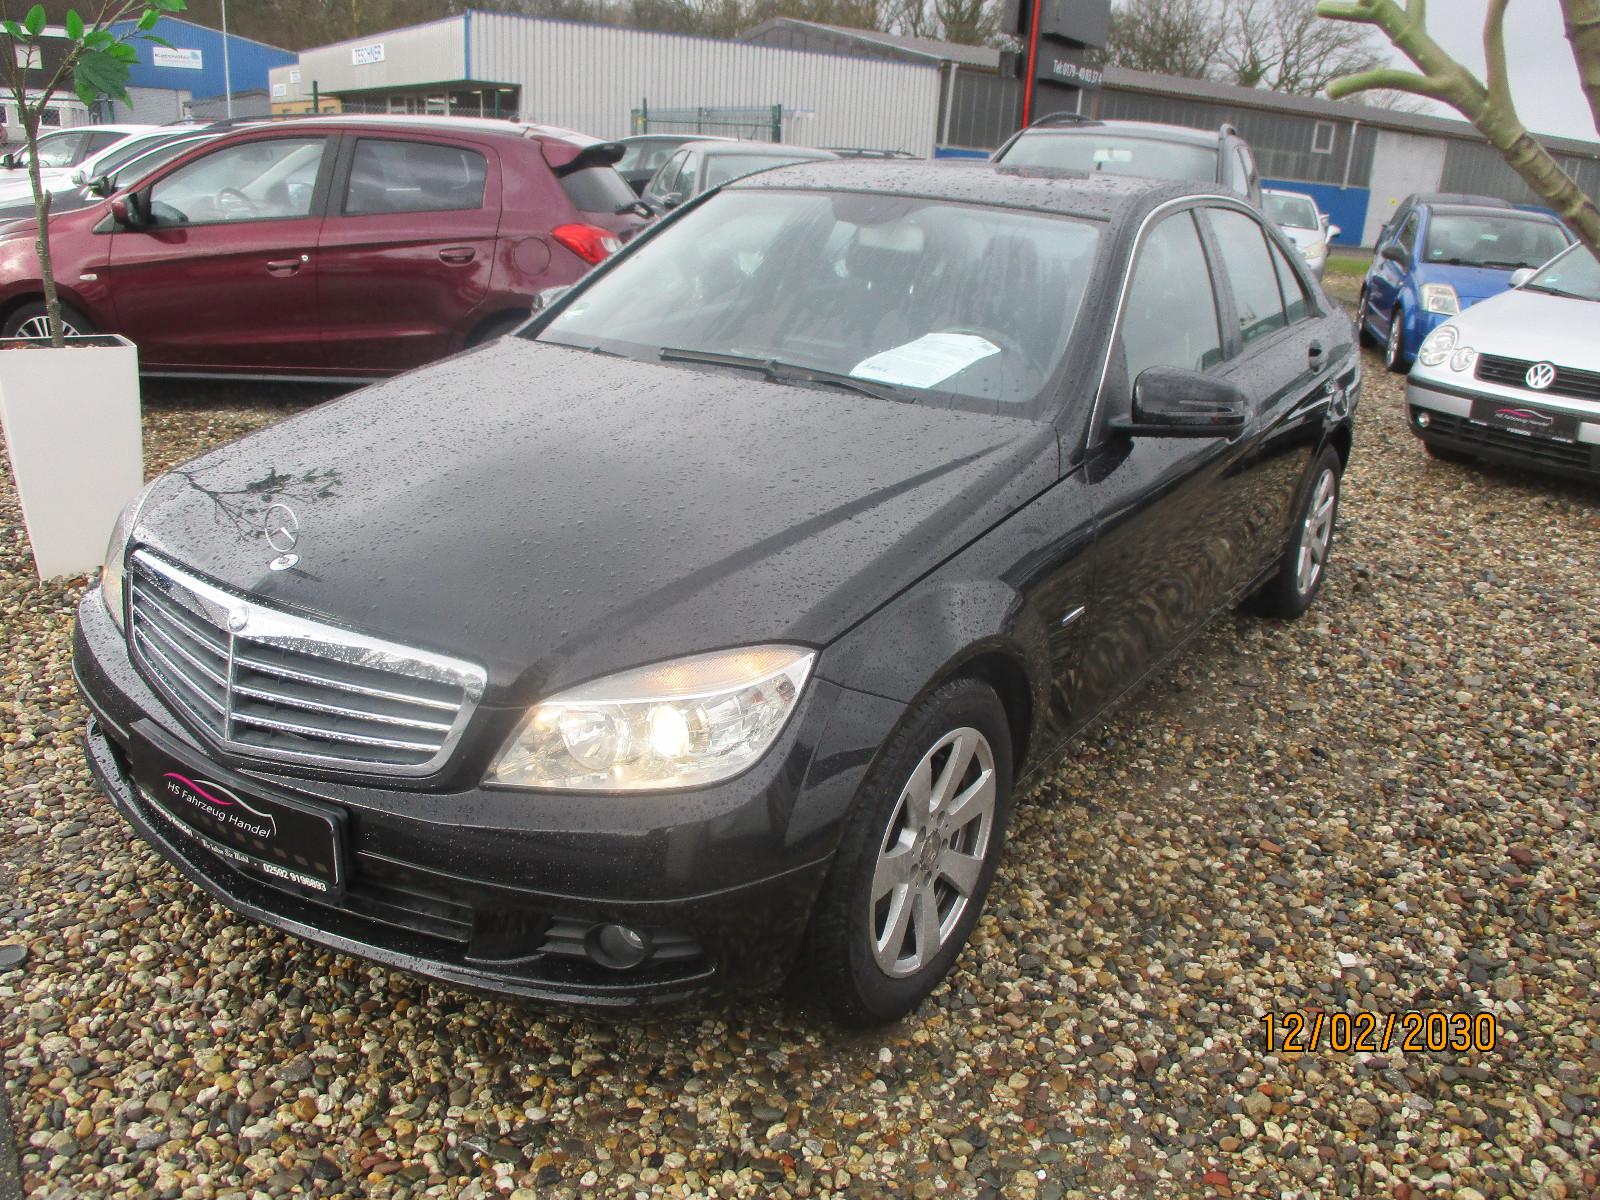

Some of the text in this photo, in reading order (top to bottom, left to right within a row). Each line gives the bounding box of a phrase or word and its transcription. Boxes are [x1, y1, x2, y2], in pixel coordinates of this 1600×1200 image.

[167, 782, 181, 795] HS
[181, 789, 226, 822] Fahrzeug
[228, 814, 271, 839] Handel
